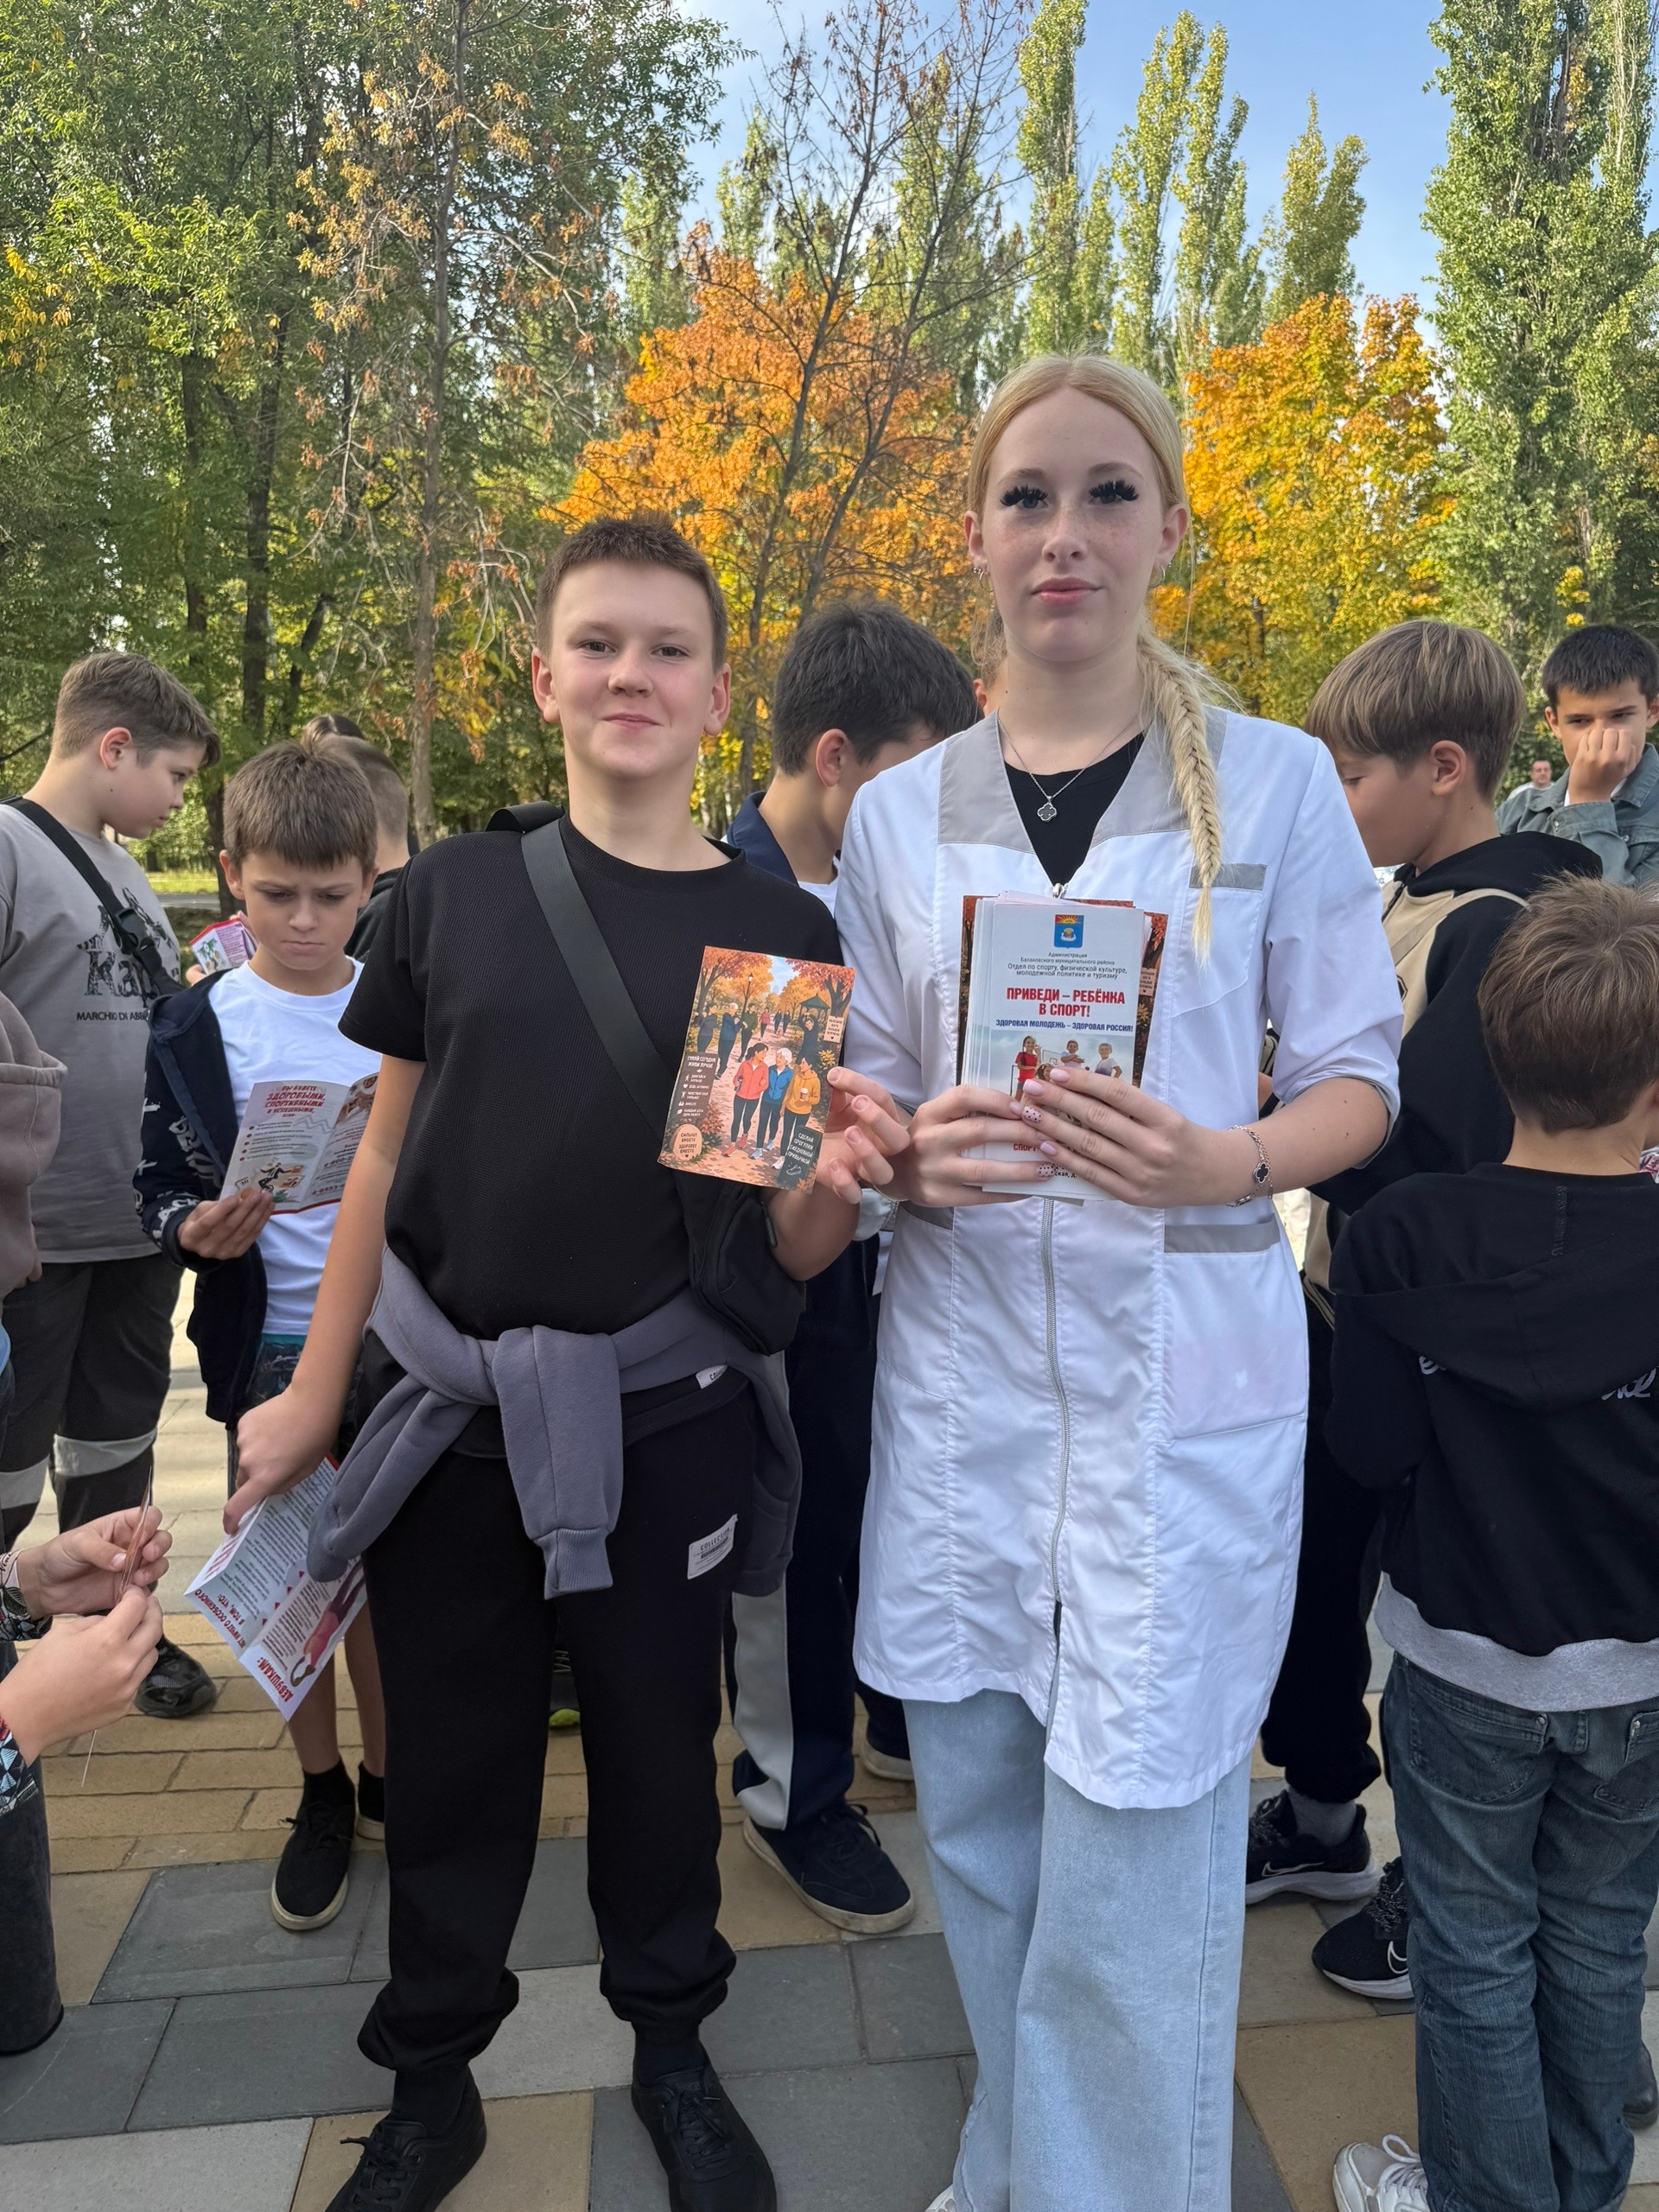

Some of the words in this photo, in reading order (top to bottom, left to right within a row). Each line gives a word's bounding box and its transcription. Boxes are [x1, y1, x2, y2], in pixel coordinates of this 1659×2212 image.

[1007, 988, 1060, 1002] ПРИВЕДИ
[1073, 988, 1125, 1004] РЕБЁНКА
[76, 1012, 118, 1020] MARCHIO
[118, 1012, 128, 1020] DI
[1039, 1003, 1046, 1015] В
[1050, 1003, 1090, 1017] СПОРТ!
[257, 1656, 294, 1703] ДЕВУШКАМ:
